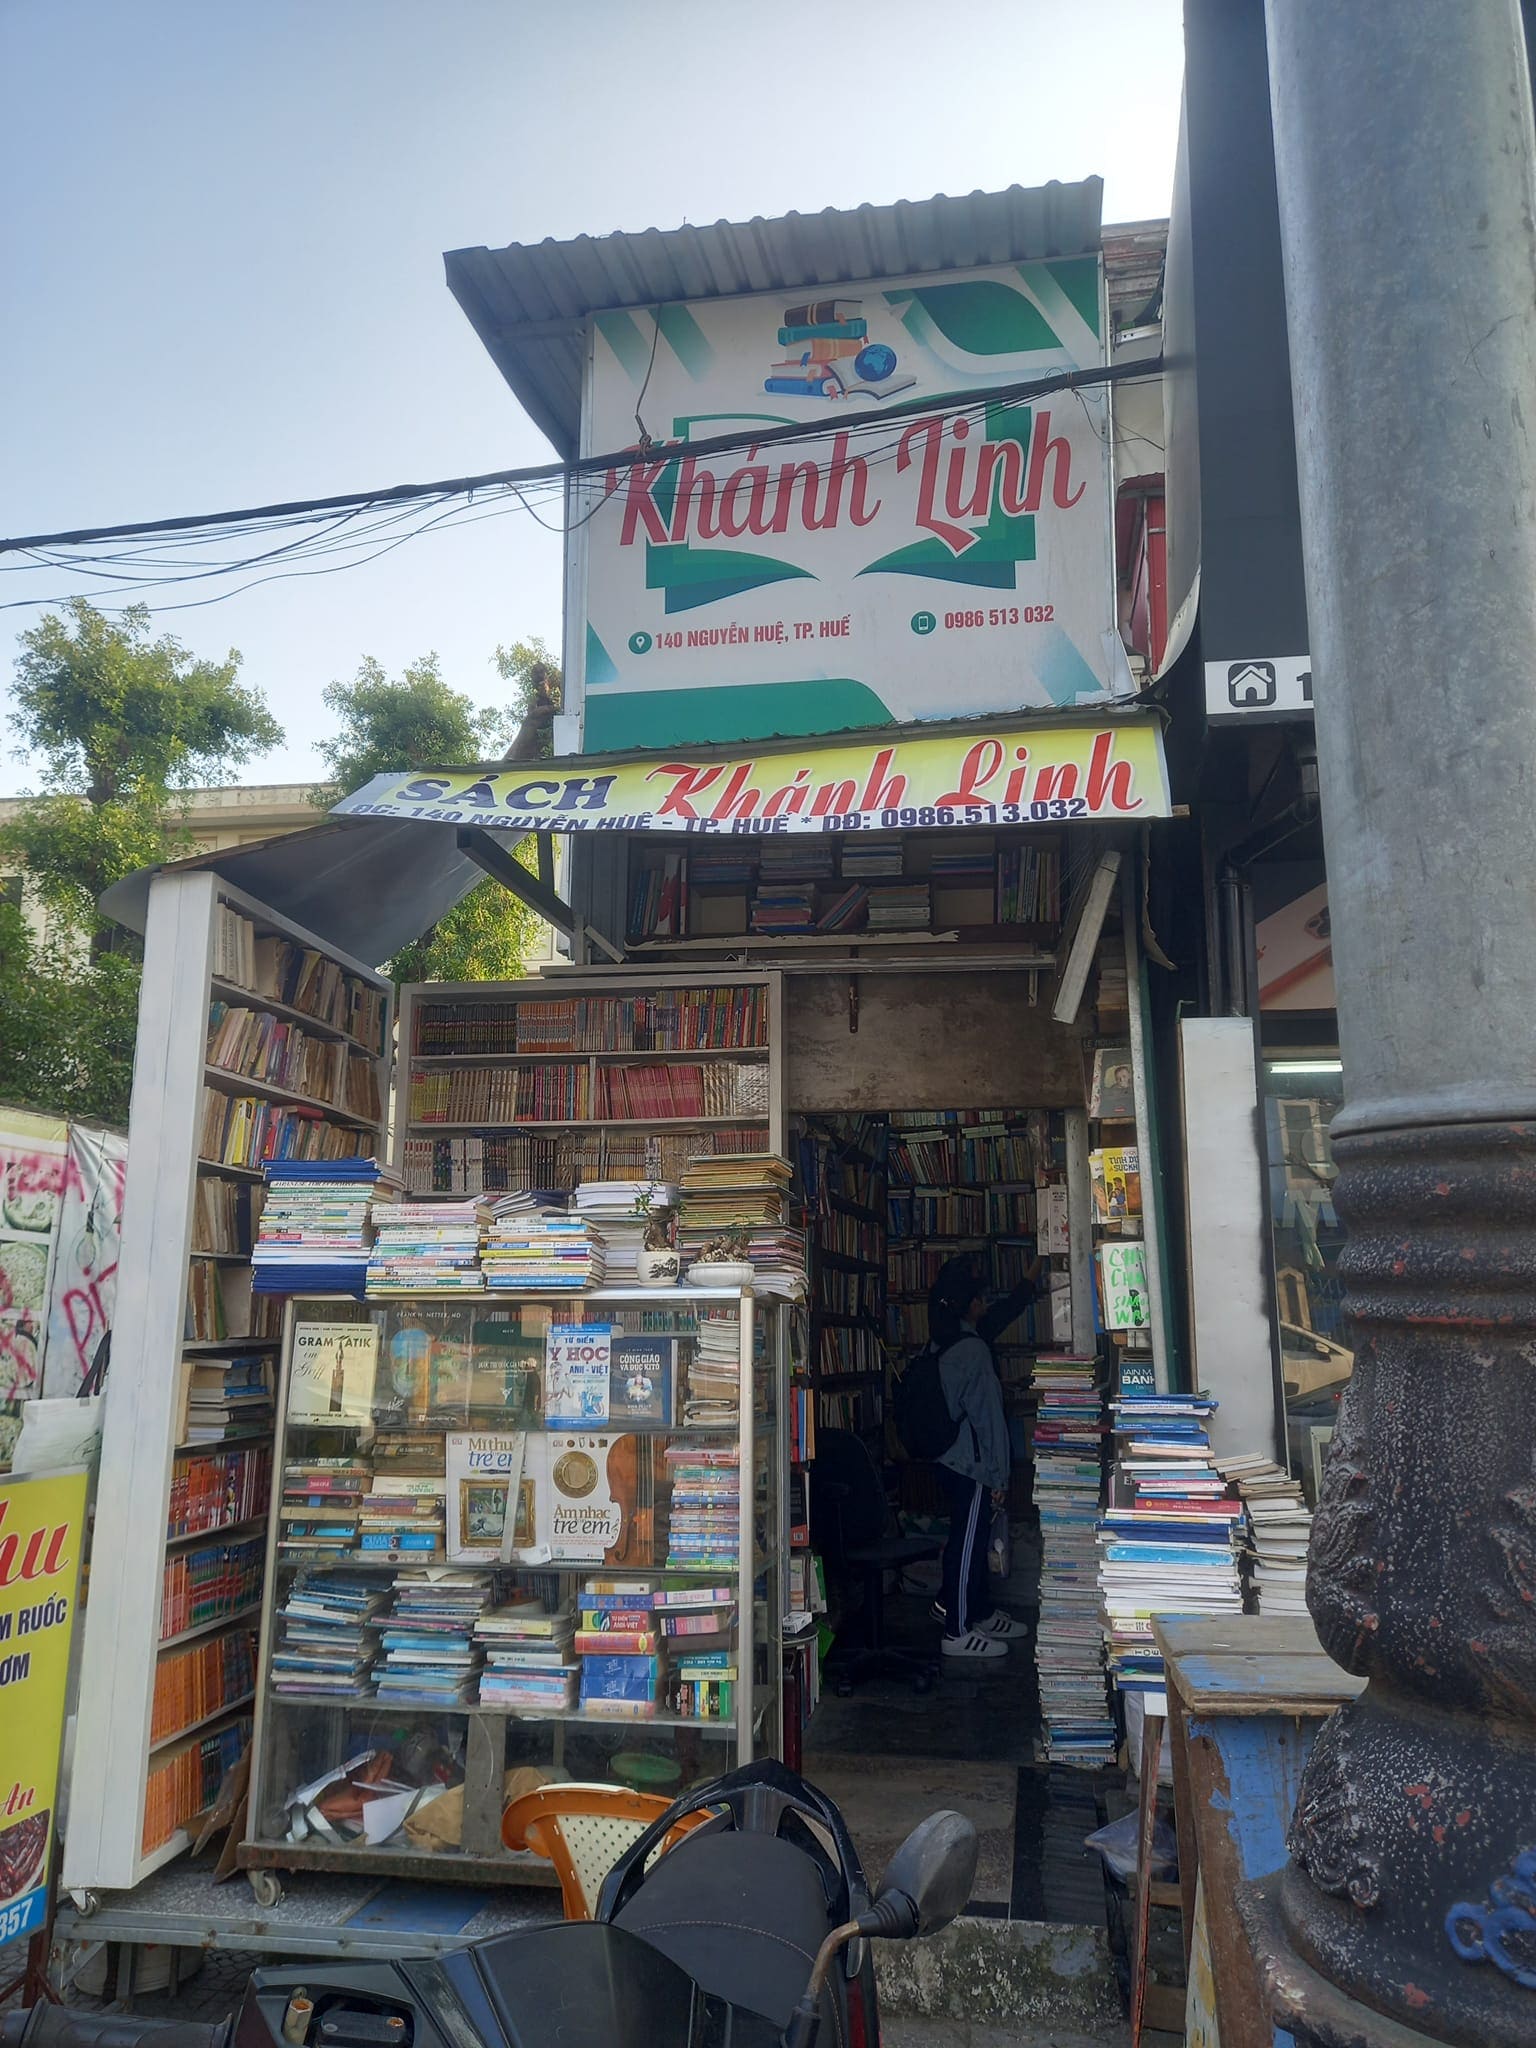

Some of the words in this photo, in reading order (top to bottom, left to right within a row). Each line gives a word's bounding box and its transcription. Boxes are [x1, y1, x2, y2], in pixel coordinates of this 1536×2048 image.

[605, 431, 882, 546] Khánh
[897, 410, 1086, 555] Linh
[656, 632, 683, 649] 140
[687, 621, 749, 647] NGUYỄN
[794, 622, 814, 640] TP.
[819, 613, 851, 638] HUẾ
[945, 611, 984, 629] 0986
[989, 608, 1019, 626] 513
[1024, 605, 1054, 623] 032
[396, 774, 618, 811] SÁCH
[645, 747, 906, 819] Khánh
[934, 731, 1143, 811] Linh
[410, 807, 463, 822] 140
[684, 816, 721, 834] TP.
[732, 812, 793, 834] HUẾ
[881, 797, 1088, 828] 0986.513.032
[549, 1347, 562, 1361] Y
[567, 1346, 609, 1364] HỌC
[17, 1591, 68, 1636] RUỐC
